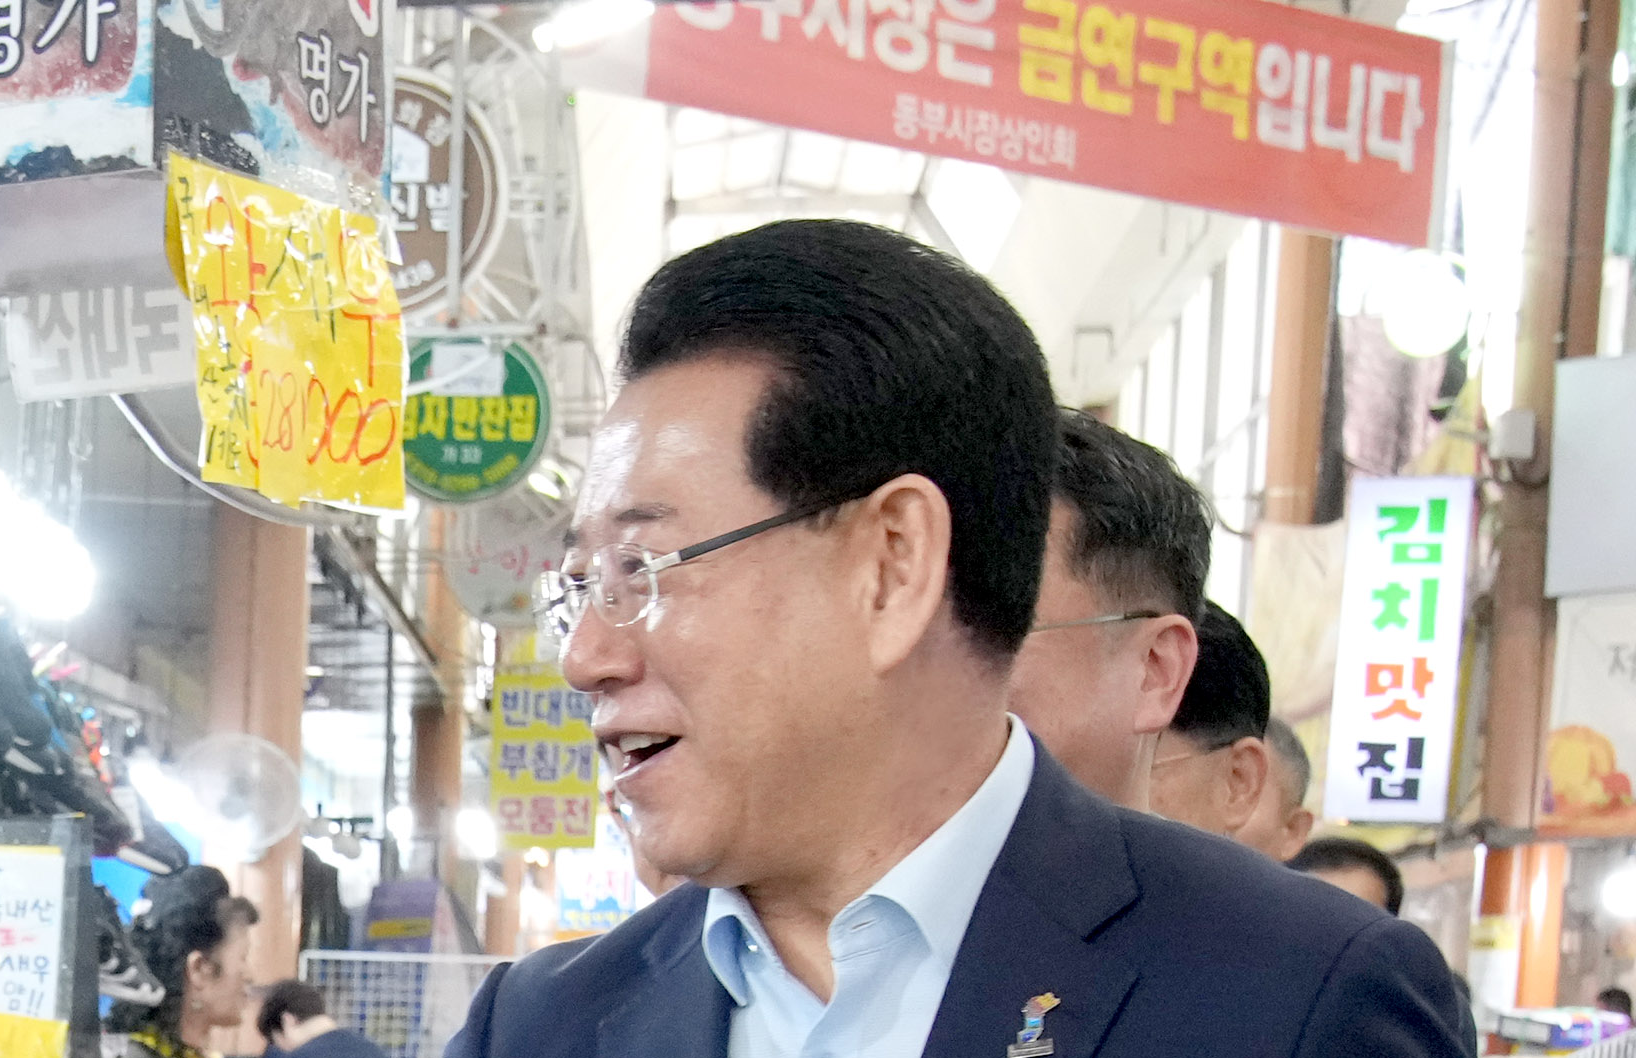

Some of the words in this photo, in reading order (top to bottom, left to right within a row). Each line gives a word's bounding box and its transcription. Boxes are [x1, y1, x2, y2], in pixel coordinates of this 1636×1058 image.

[297, 34, 377, 144] 명가
[1018, 0, 1426, 173] 금연구역입니다
[1357, 498, 1448, 802] 김치맛집
[499, 742, 593, 782] 부침개
